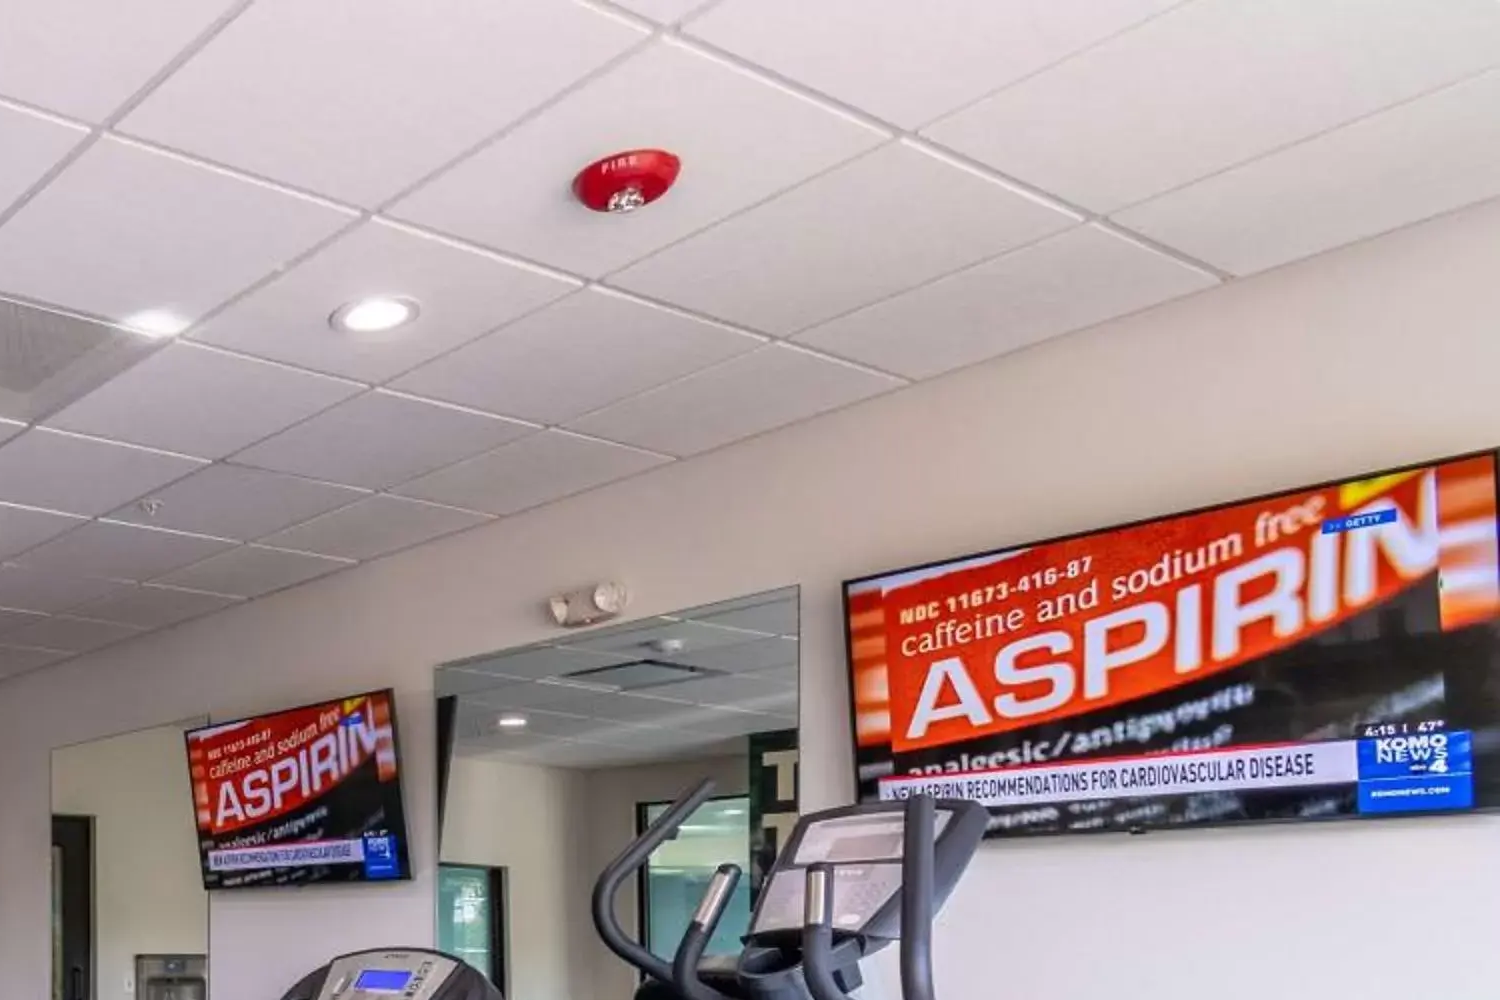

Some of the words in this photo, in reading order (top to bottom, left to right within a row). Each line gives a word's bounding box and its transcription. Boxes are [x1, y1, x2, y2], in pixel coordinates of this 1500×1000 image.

[900, 602, 940, 625] NDC
[946, 556, 1093, 613] 11673-416-87
[901, 608, 1025, 657] caffeine
[1037, 578, 1099, 623] and
[1111, 532, 1243, 601] sodium
[1255, 495, 1326, 548] free
[905, 467, 1440, 740] ASPIRIN
[209, 755, 251, 779] caffeine
[254, 742, 275, 764] and
[216, 697, 377, 827] ASPIRIN
[1376, 733, 1448, 752] KOMO
[1376, 747, 1449, 763] NEWS
[967, 771, 1089, 799] RECOMMENDATIONS
[1091, 769, 1117, 791] FOR
[1120, 758, 1247, 789] CARDIOVASCULAR
[1250, 753, 1315, 779] DISEASE
[1428, 759, 1449, 773] 4
